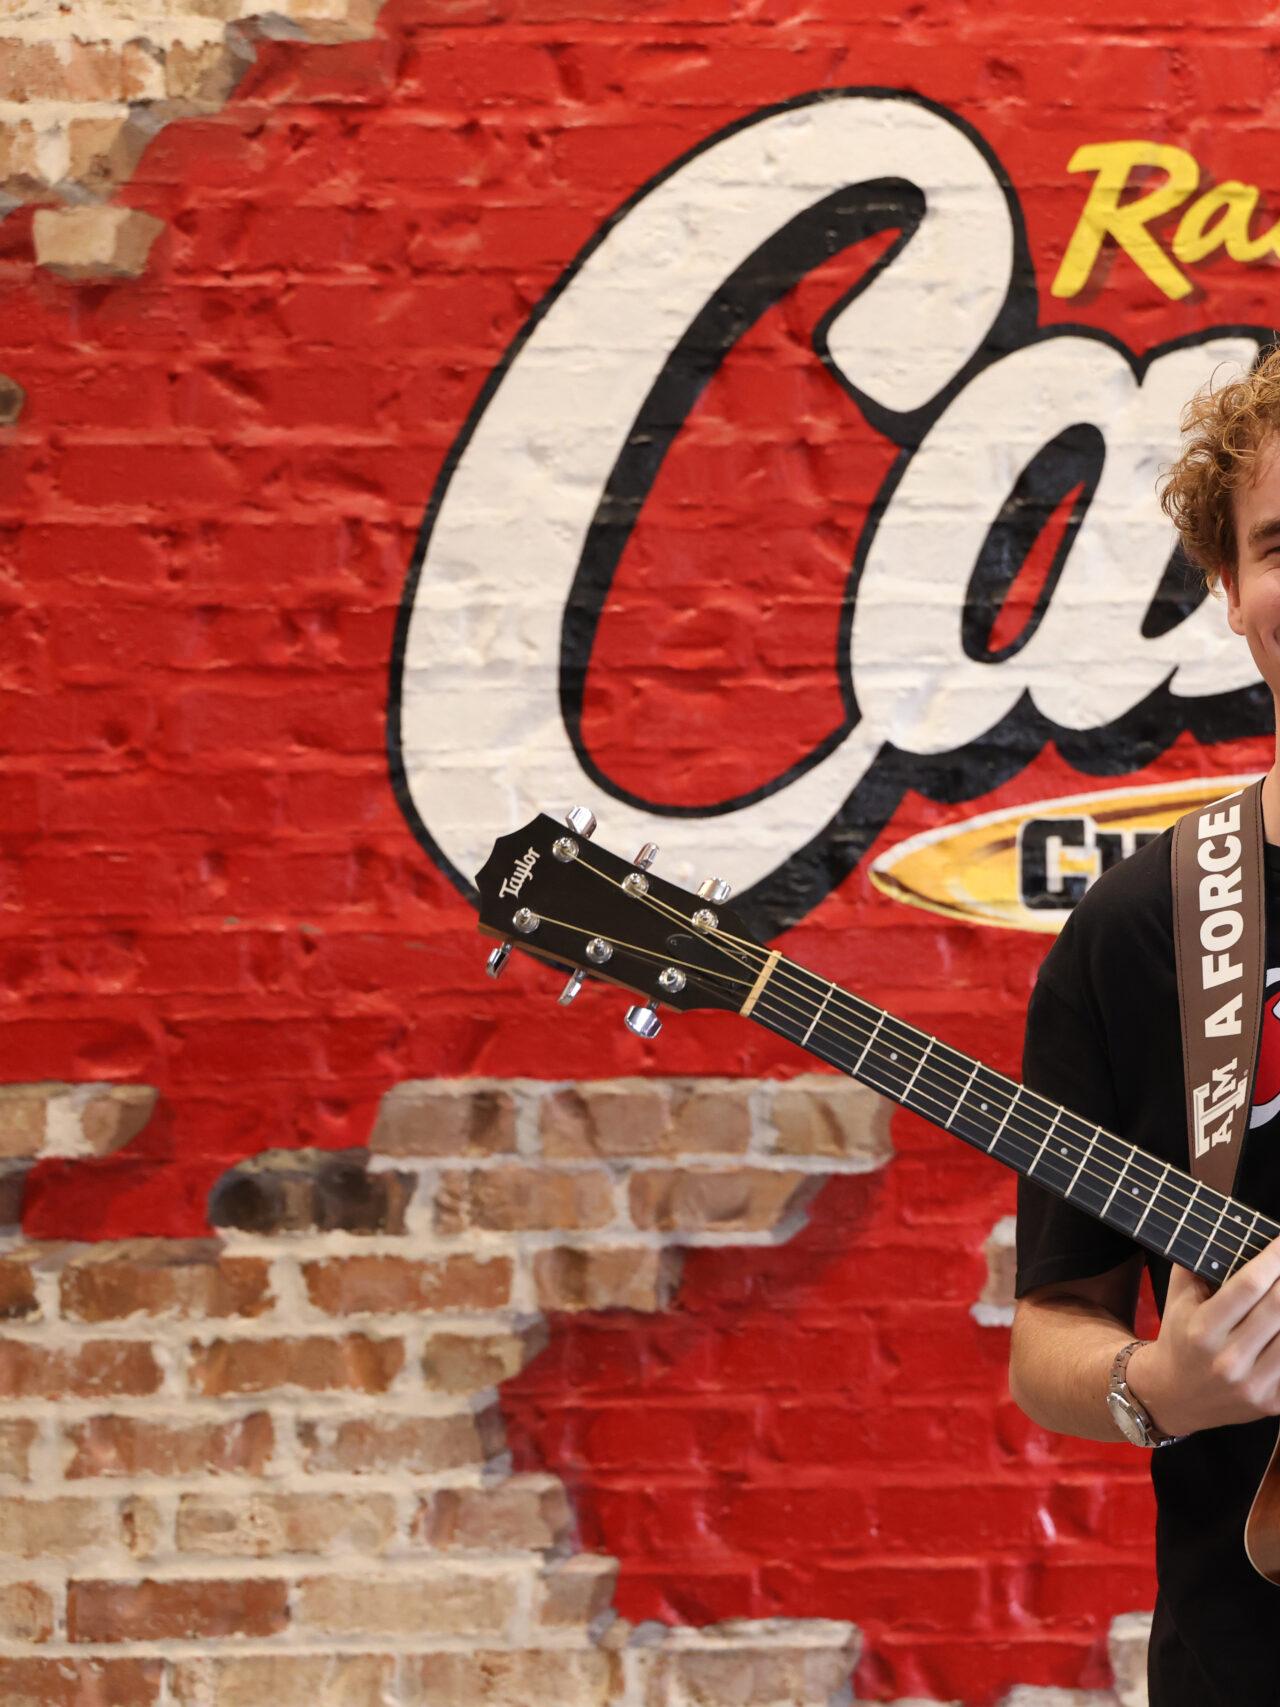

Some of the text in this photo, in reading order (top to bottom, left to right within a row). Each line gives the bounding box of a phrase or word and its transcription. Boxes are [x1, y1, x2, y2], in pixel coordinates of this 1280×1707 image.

[499, 846, 541, 899] Taylor
[1197, 803, 1245, 990] FORCE
[1204, 993, 1243, 1038] A
